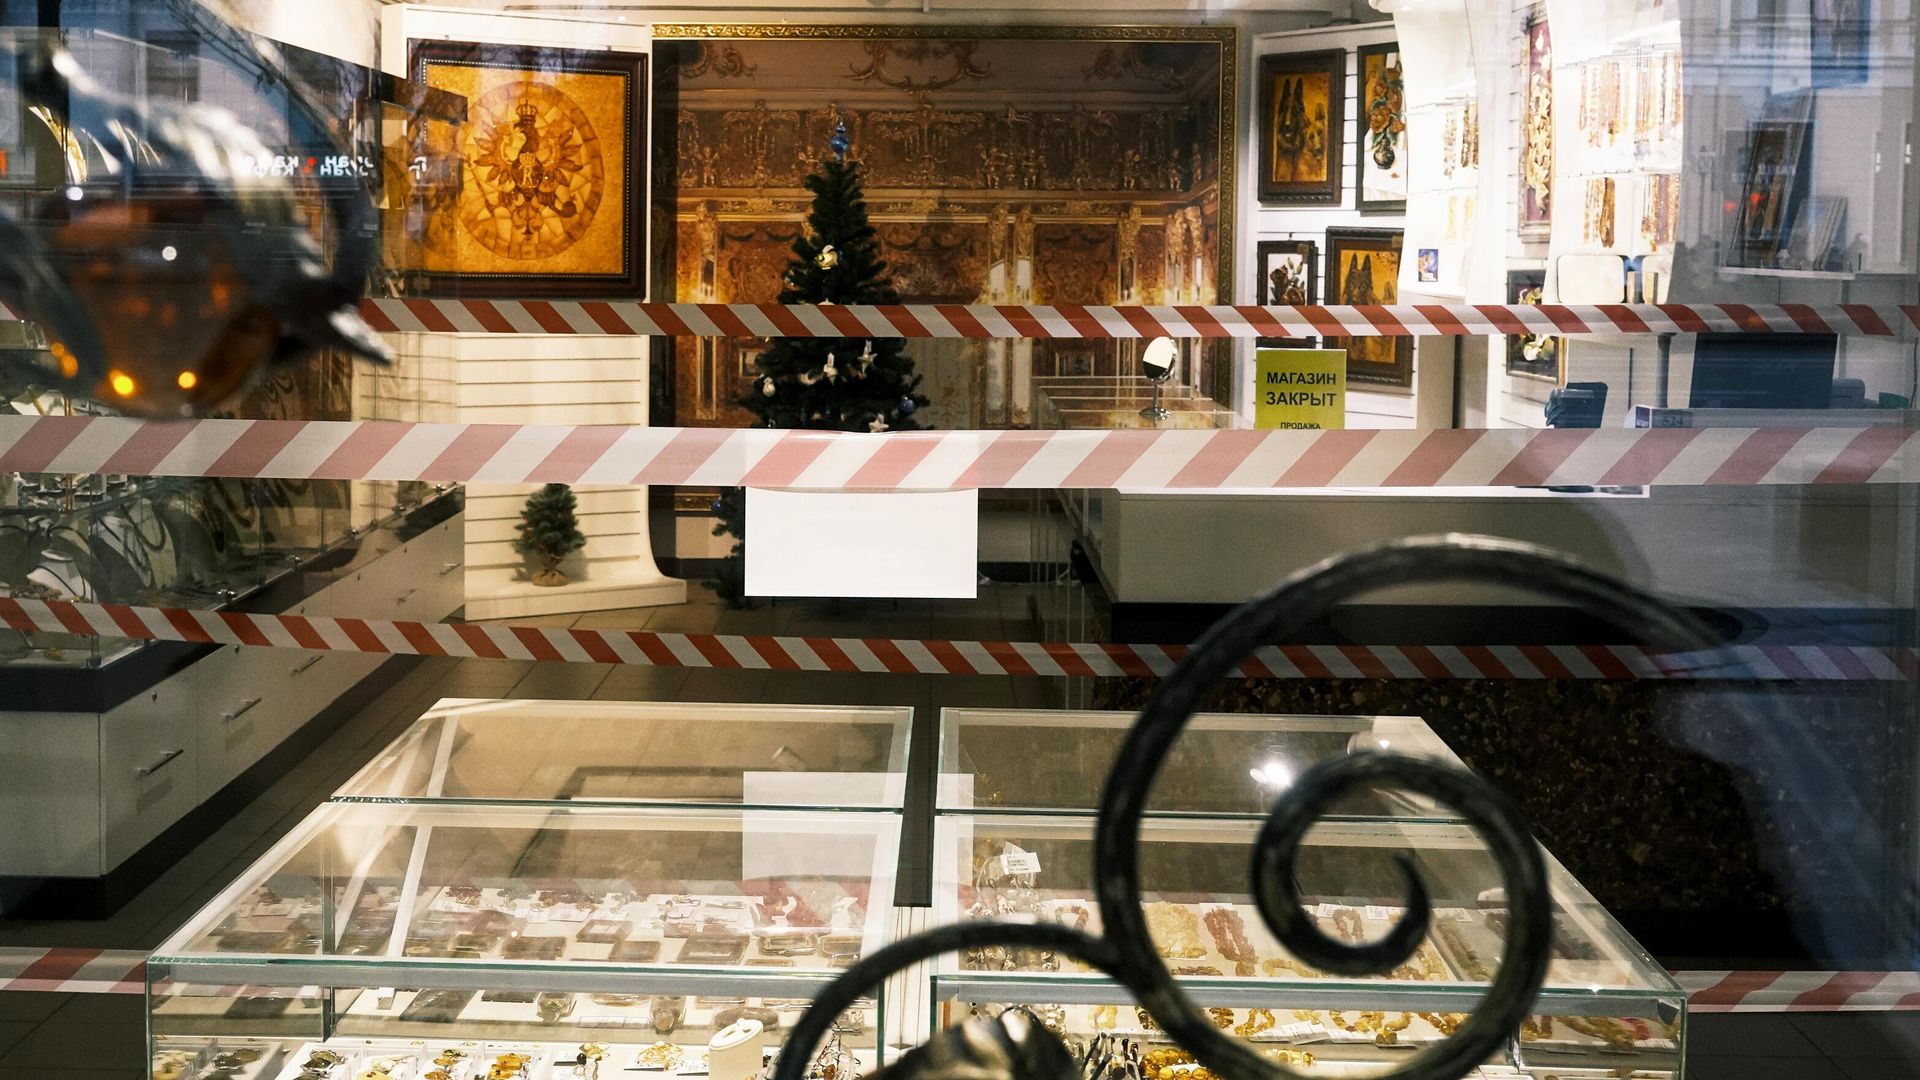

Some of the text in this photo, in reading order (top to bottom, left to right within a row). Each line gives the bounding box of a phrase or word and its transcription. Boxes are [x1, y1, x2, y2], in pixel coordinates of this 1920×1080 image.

[1266, 372, 1337, 385] МАГАЗИН
[1266, 391, 1337, 406] ЗАКРЫТ
[1280, 422, 1321, 430] ПРОДАЖА
